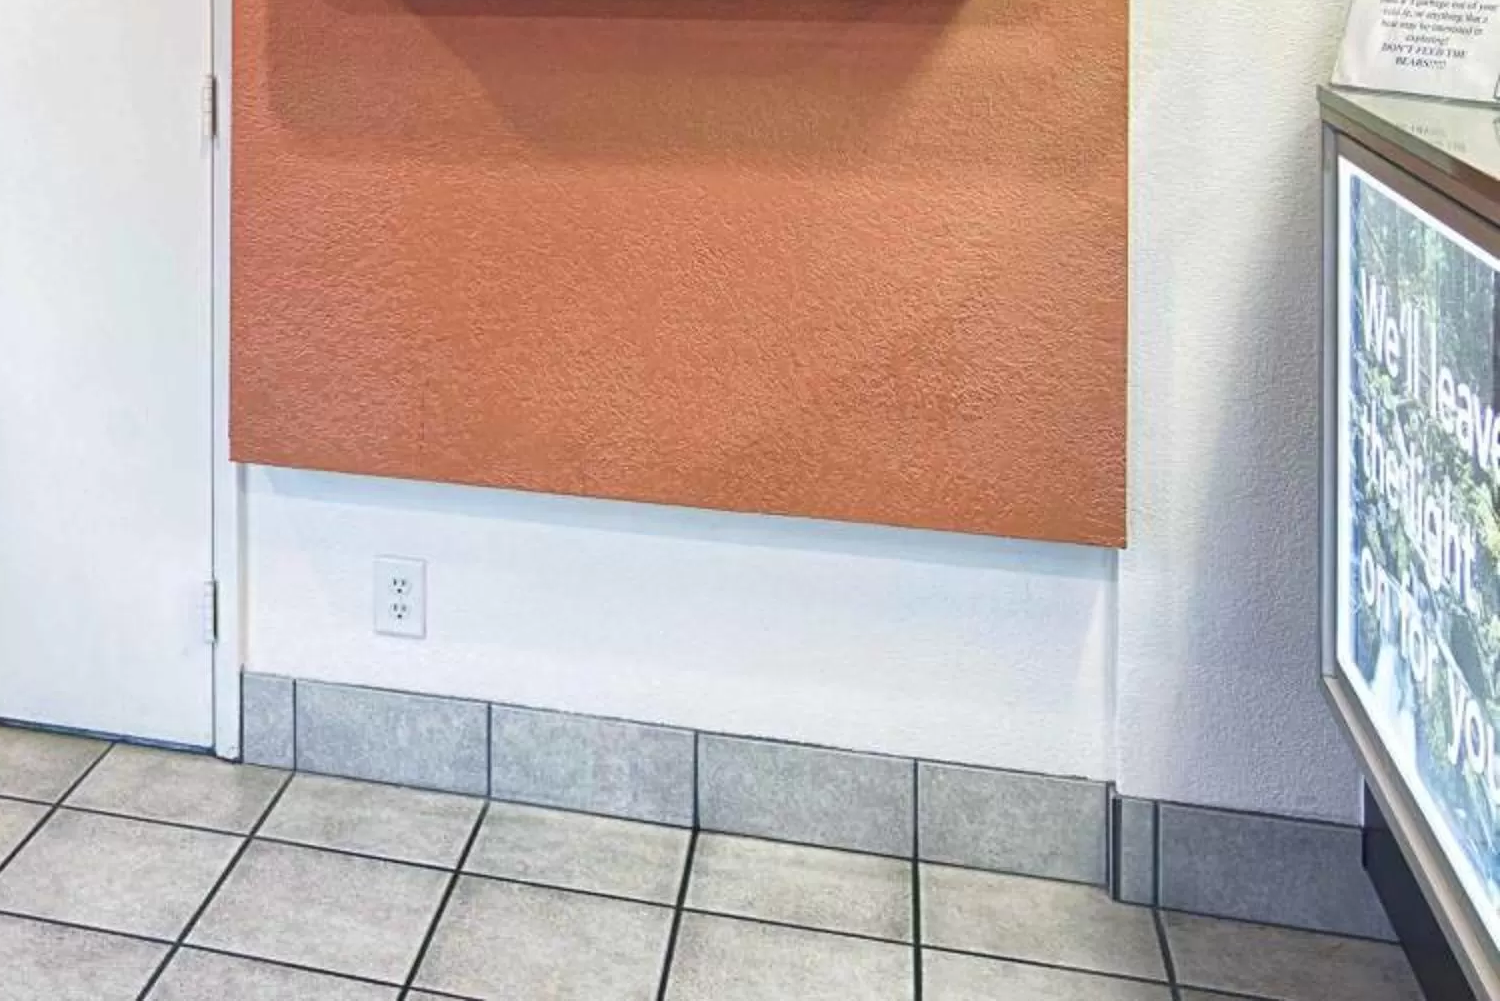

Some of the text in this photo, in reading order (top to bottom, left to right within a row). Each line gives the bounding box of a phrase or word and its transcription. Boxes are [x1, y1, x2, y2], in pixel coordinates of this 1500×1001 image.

[1360, 266, 1419, 401] We'll
[1362, 399, 1480, 615] the light
[1361, 547, 1392, 632] on
[1400, 569, 1438, 699] for
